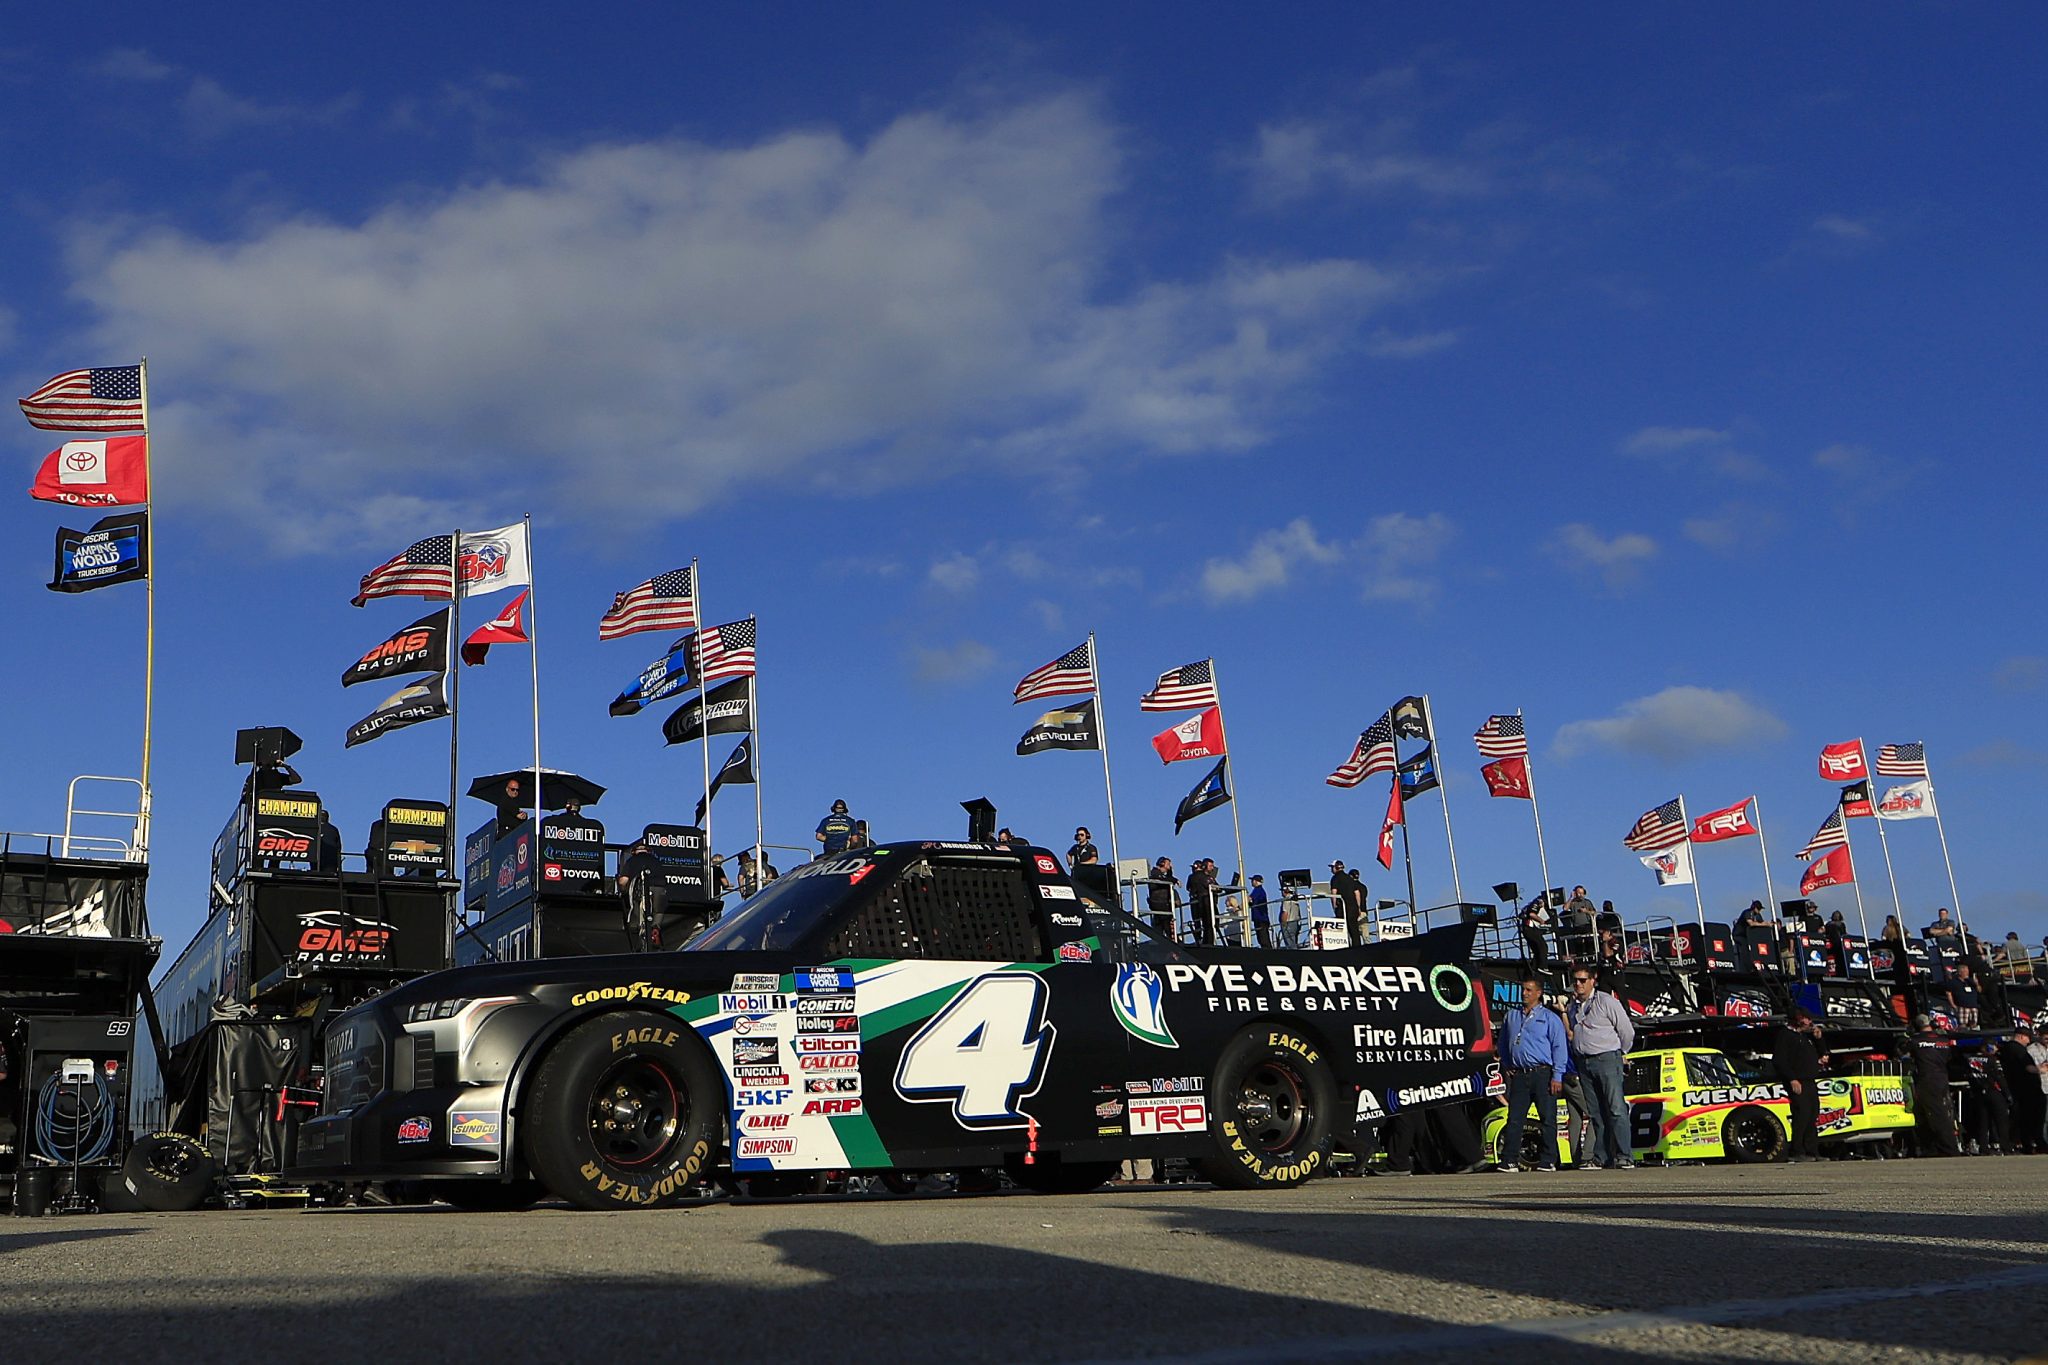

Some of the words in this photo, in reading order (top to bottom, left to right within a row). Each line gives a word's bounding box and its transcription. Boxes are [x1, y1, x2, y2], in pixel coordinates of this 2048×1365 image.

[56, 493, 119, 504] TOYOTA
[73, 542, 117, 558] AMPING
[72, 552, 120, 569] WORLD
[458, 553, 506, 582] BM
[77, 568, 98, 578] TRUCK
[98, 565, 118, 575] SERIES
[360, 631, 430, 663] GMS
[357, 649, 428, 672] RACING
[1023, 732, 1090, 746] CHEVROLET
[1180, 746, 1210, 758] TOYOTA
[259, 799, 318, 816] CHAMPION
[389, 808, 446, 824] CHAMPION
[544, 825, 584, 841] Mobil
[585, 829, 598, 842] 1
[648, 833, 685, 848] Mobil
[686, 836, 699, 849] 1
[259, 838, 310, 852] GMS
[257, 850, 308, 858] RACING
[388, 853, 444, 864] CHEVROLET
[562, 869, 600, 880] TOYOTA
[665, 875, 702, 886] TOYOTA
[1803, 876, 1837, 892] TOYOTA
[1051, 913, 1082, 927] Rowdy
[1382, 924, 1412, 934] HRE
[299, 928, 389, 952] GMS
[1325, 937, 1348, 945] TOYOTA
[1060, 947, 1090, 960] KBM
[748, 975, 774, 983] NASCAR
[810, 979, 840, 988] WORLD
[1165, 964, 1249, 992] PYE
[1268, 964, 1426, 992] BARKER
[571, 983, 691, 1007] GOODYEAR
[722, 994, 768, 1010] Mobil
[772, 994, 787, 1009] 1
[798, 996, 855, 1011] COMETIC
[1207, 997, 1269, 1012] FIRE
[1281, 996, 1295, 1011] &
[1305, 996, 1399, 1011] SAFETY
[106, 1021, 131, 1036] 99
[798, 1017, 835, 1032] Holley
[611, 1027, 680, 1053] EAGLE
[1353, 1024, 1397, 1047] Fire
[1402, 1023, 1465, 1046] Alarm
[799, 1037, 858, 1051] tilton
[893, 970, 1057, 1131] 4
[1268, 1032, 1320, 1064] EAGLE
[800, 1055, 857, 1069] CALICO
[1356, 1049, 1465, 1064] SERVICES,INC
[735, 1067, 780, 1077] LINCOLN
[745, 1077, 785, 1086] WELDERS
[804, 1077, 857, 1094] KOOKS
[1152, 1077, 1189, 1092] Mobil
[1190, 1077, 1202, 1090] 1
[736, 1090, 793, 1106] SKF
[802, 1099, 862, 1115] ARP
[1130, 1104, 1205, 1132] TRD
[1355, 1109, 1386, 1123] AXALTA
[399, 1123, 429, 1139] KBM
[455, 1125, 497, 1134] SUNOCO
[742, 1139, 793, 1155] SIMPSON
[1222, 1120, 1321, 1181] GOODYEAR
[580, 1140, 709, 1205] GOODYEAR
